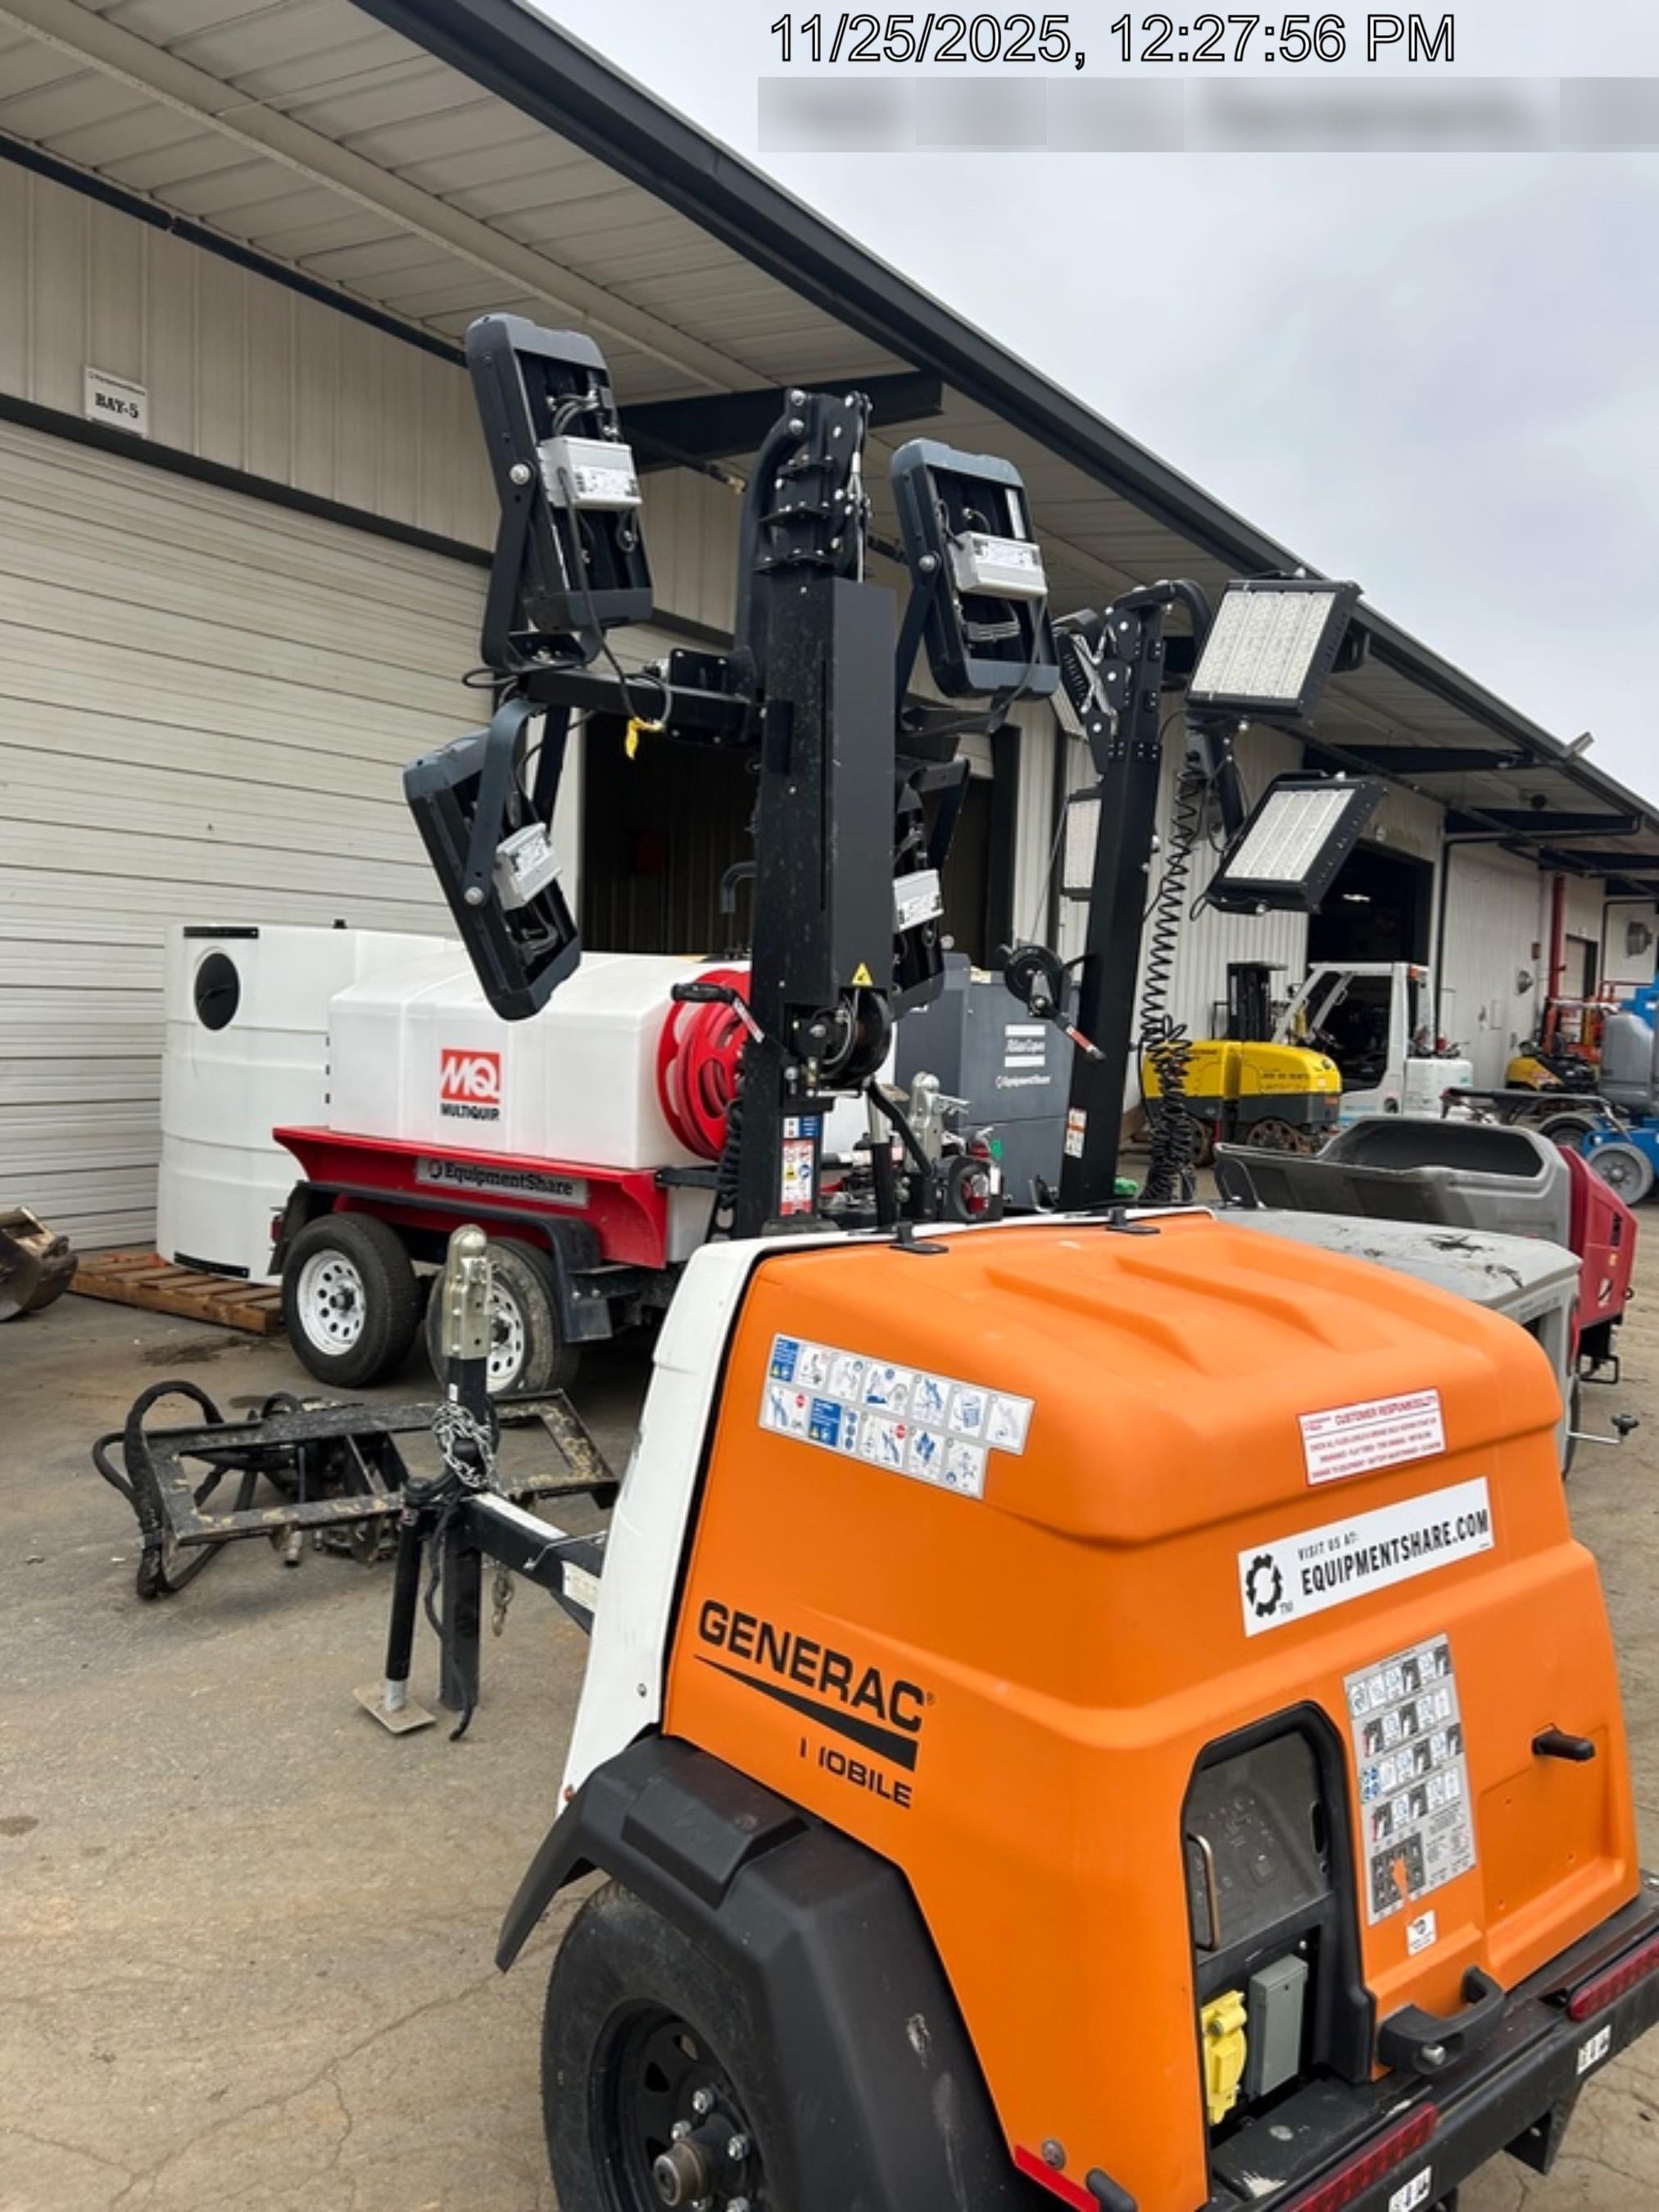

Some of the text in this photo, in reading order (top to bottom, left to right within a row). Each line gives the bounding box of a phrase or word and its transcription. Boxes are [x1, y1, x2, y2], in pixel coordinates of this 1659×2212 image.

[95, 392, 139, 419] BAY-5
[441, 1056, 500, 1099] MQ
[441, 1103, 499, 1121] MULTIQUIP
[445, 1163, 573, 1195] EquipmentShare
[1298, 1540, 1326, 1561] VISIT
[1328, 1536, 1341, 1551] US
[1300, 1508, 1489, 1596] EQUIPMENTSHARE.COM
[699, 1599, 923, 1734] GENERAC
